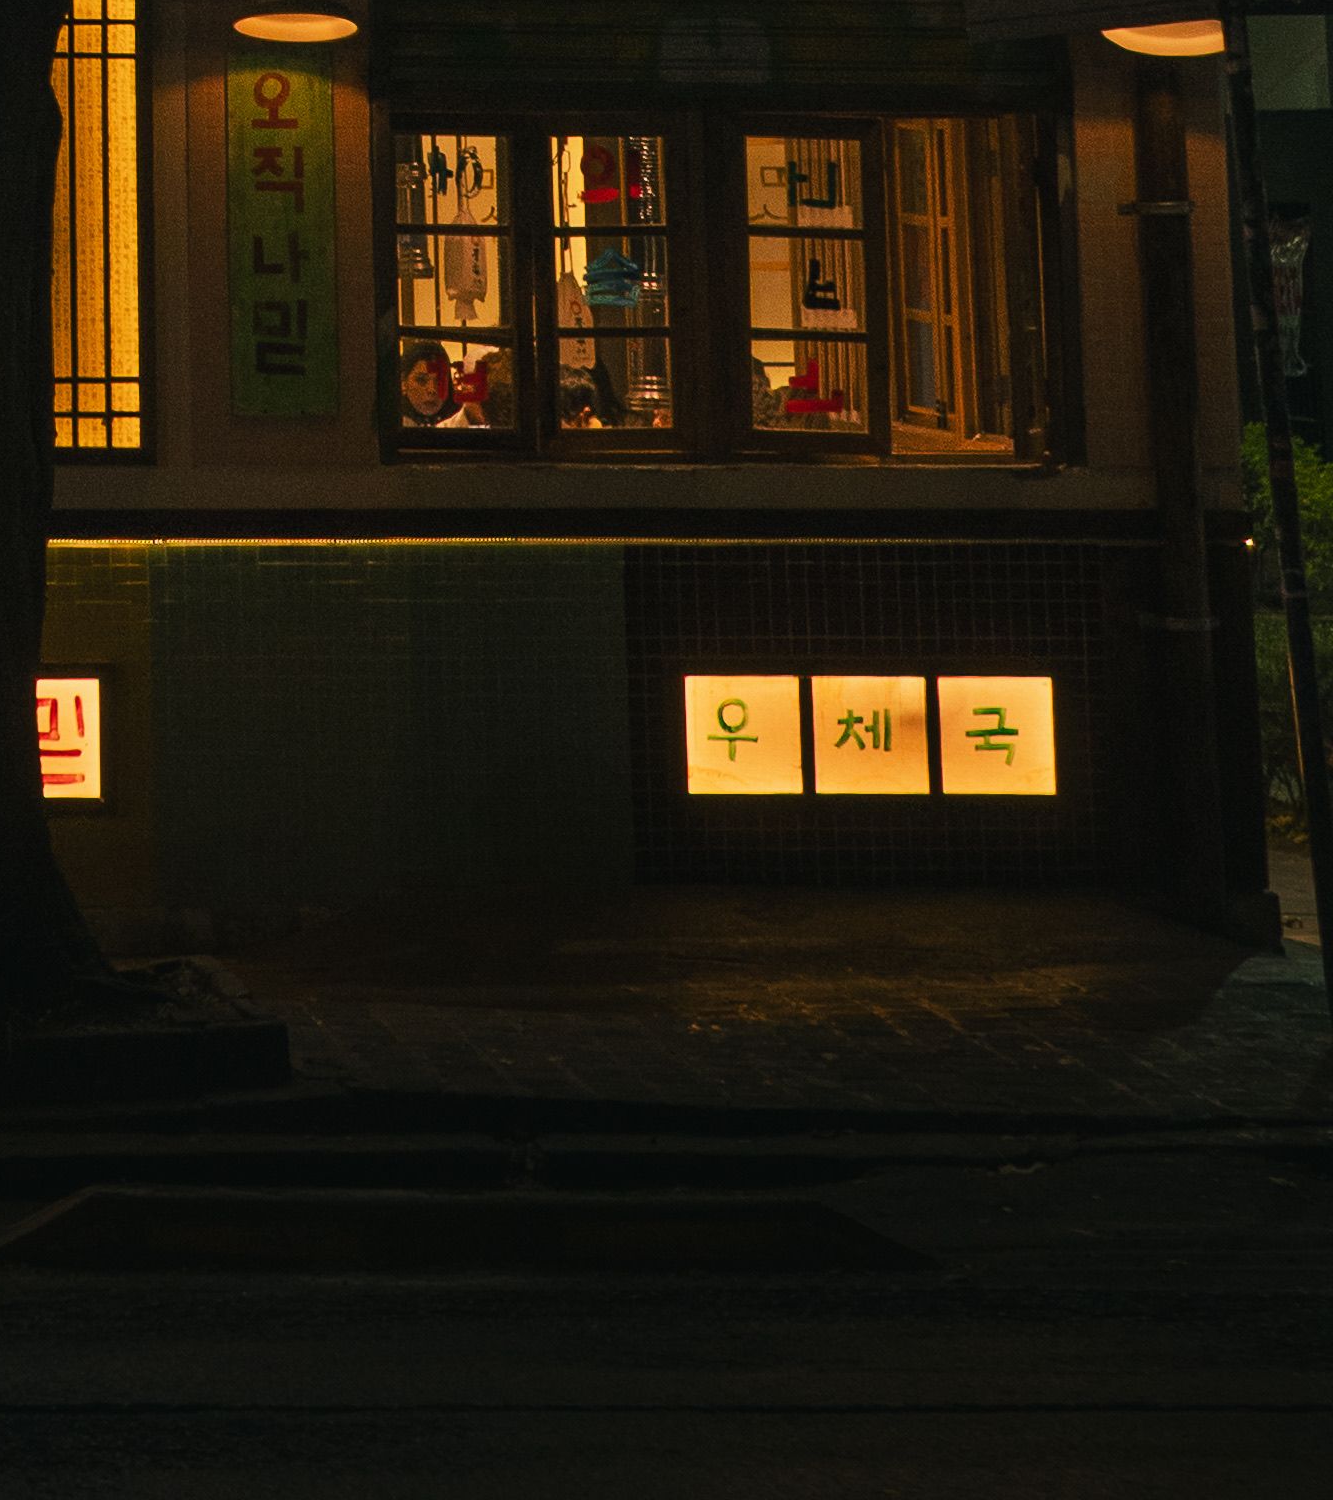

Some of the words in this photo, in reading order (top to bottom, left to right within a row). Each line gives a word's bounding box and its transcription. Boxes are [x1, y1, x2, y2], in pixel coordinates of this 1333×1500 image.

[706, 698, 760, 761] 우
[834, 707, 894, 753] 체
[965, 705, 1022, 768] 국
